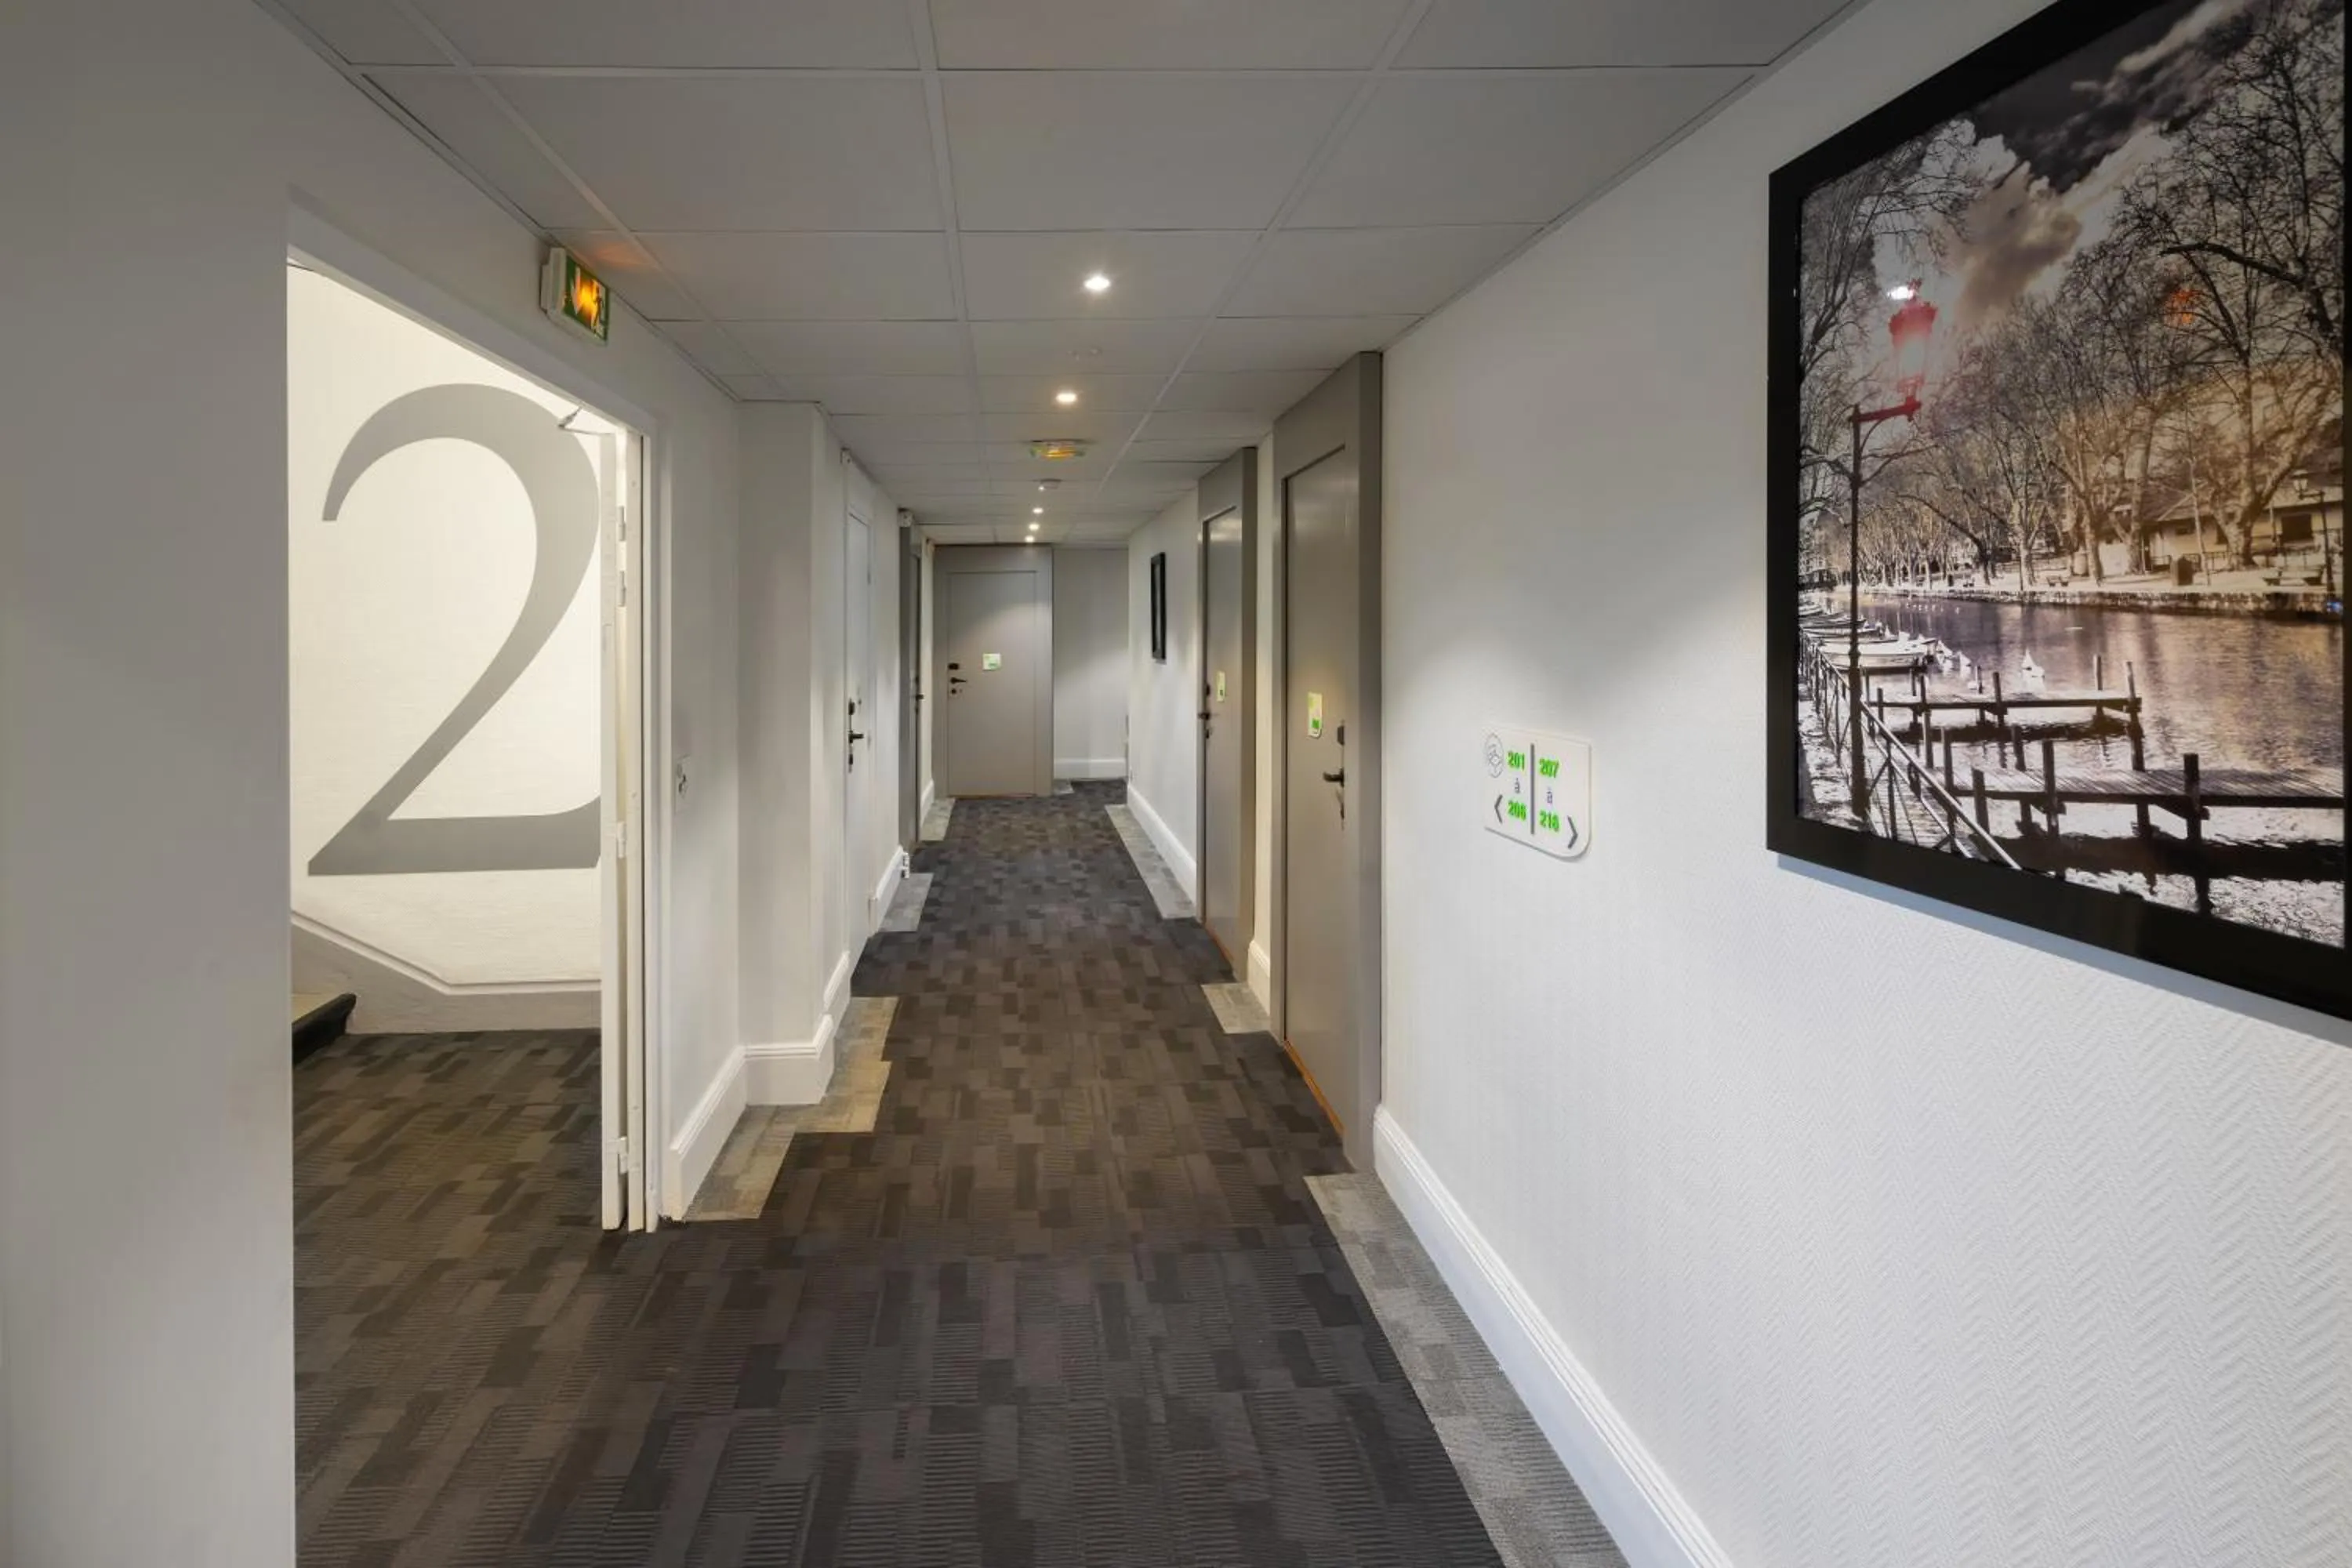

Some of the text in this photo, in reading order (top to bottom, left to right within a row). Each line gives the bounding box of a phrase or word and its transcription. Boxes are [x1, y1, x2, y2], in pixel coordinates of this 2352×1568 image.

[308, 383, 601, 876] 2
[1508, 751, 1525, 771] 201
[1539, 757, 1559, 778] 207
